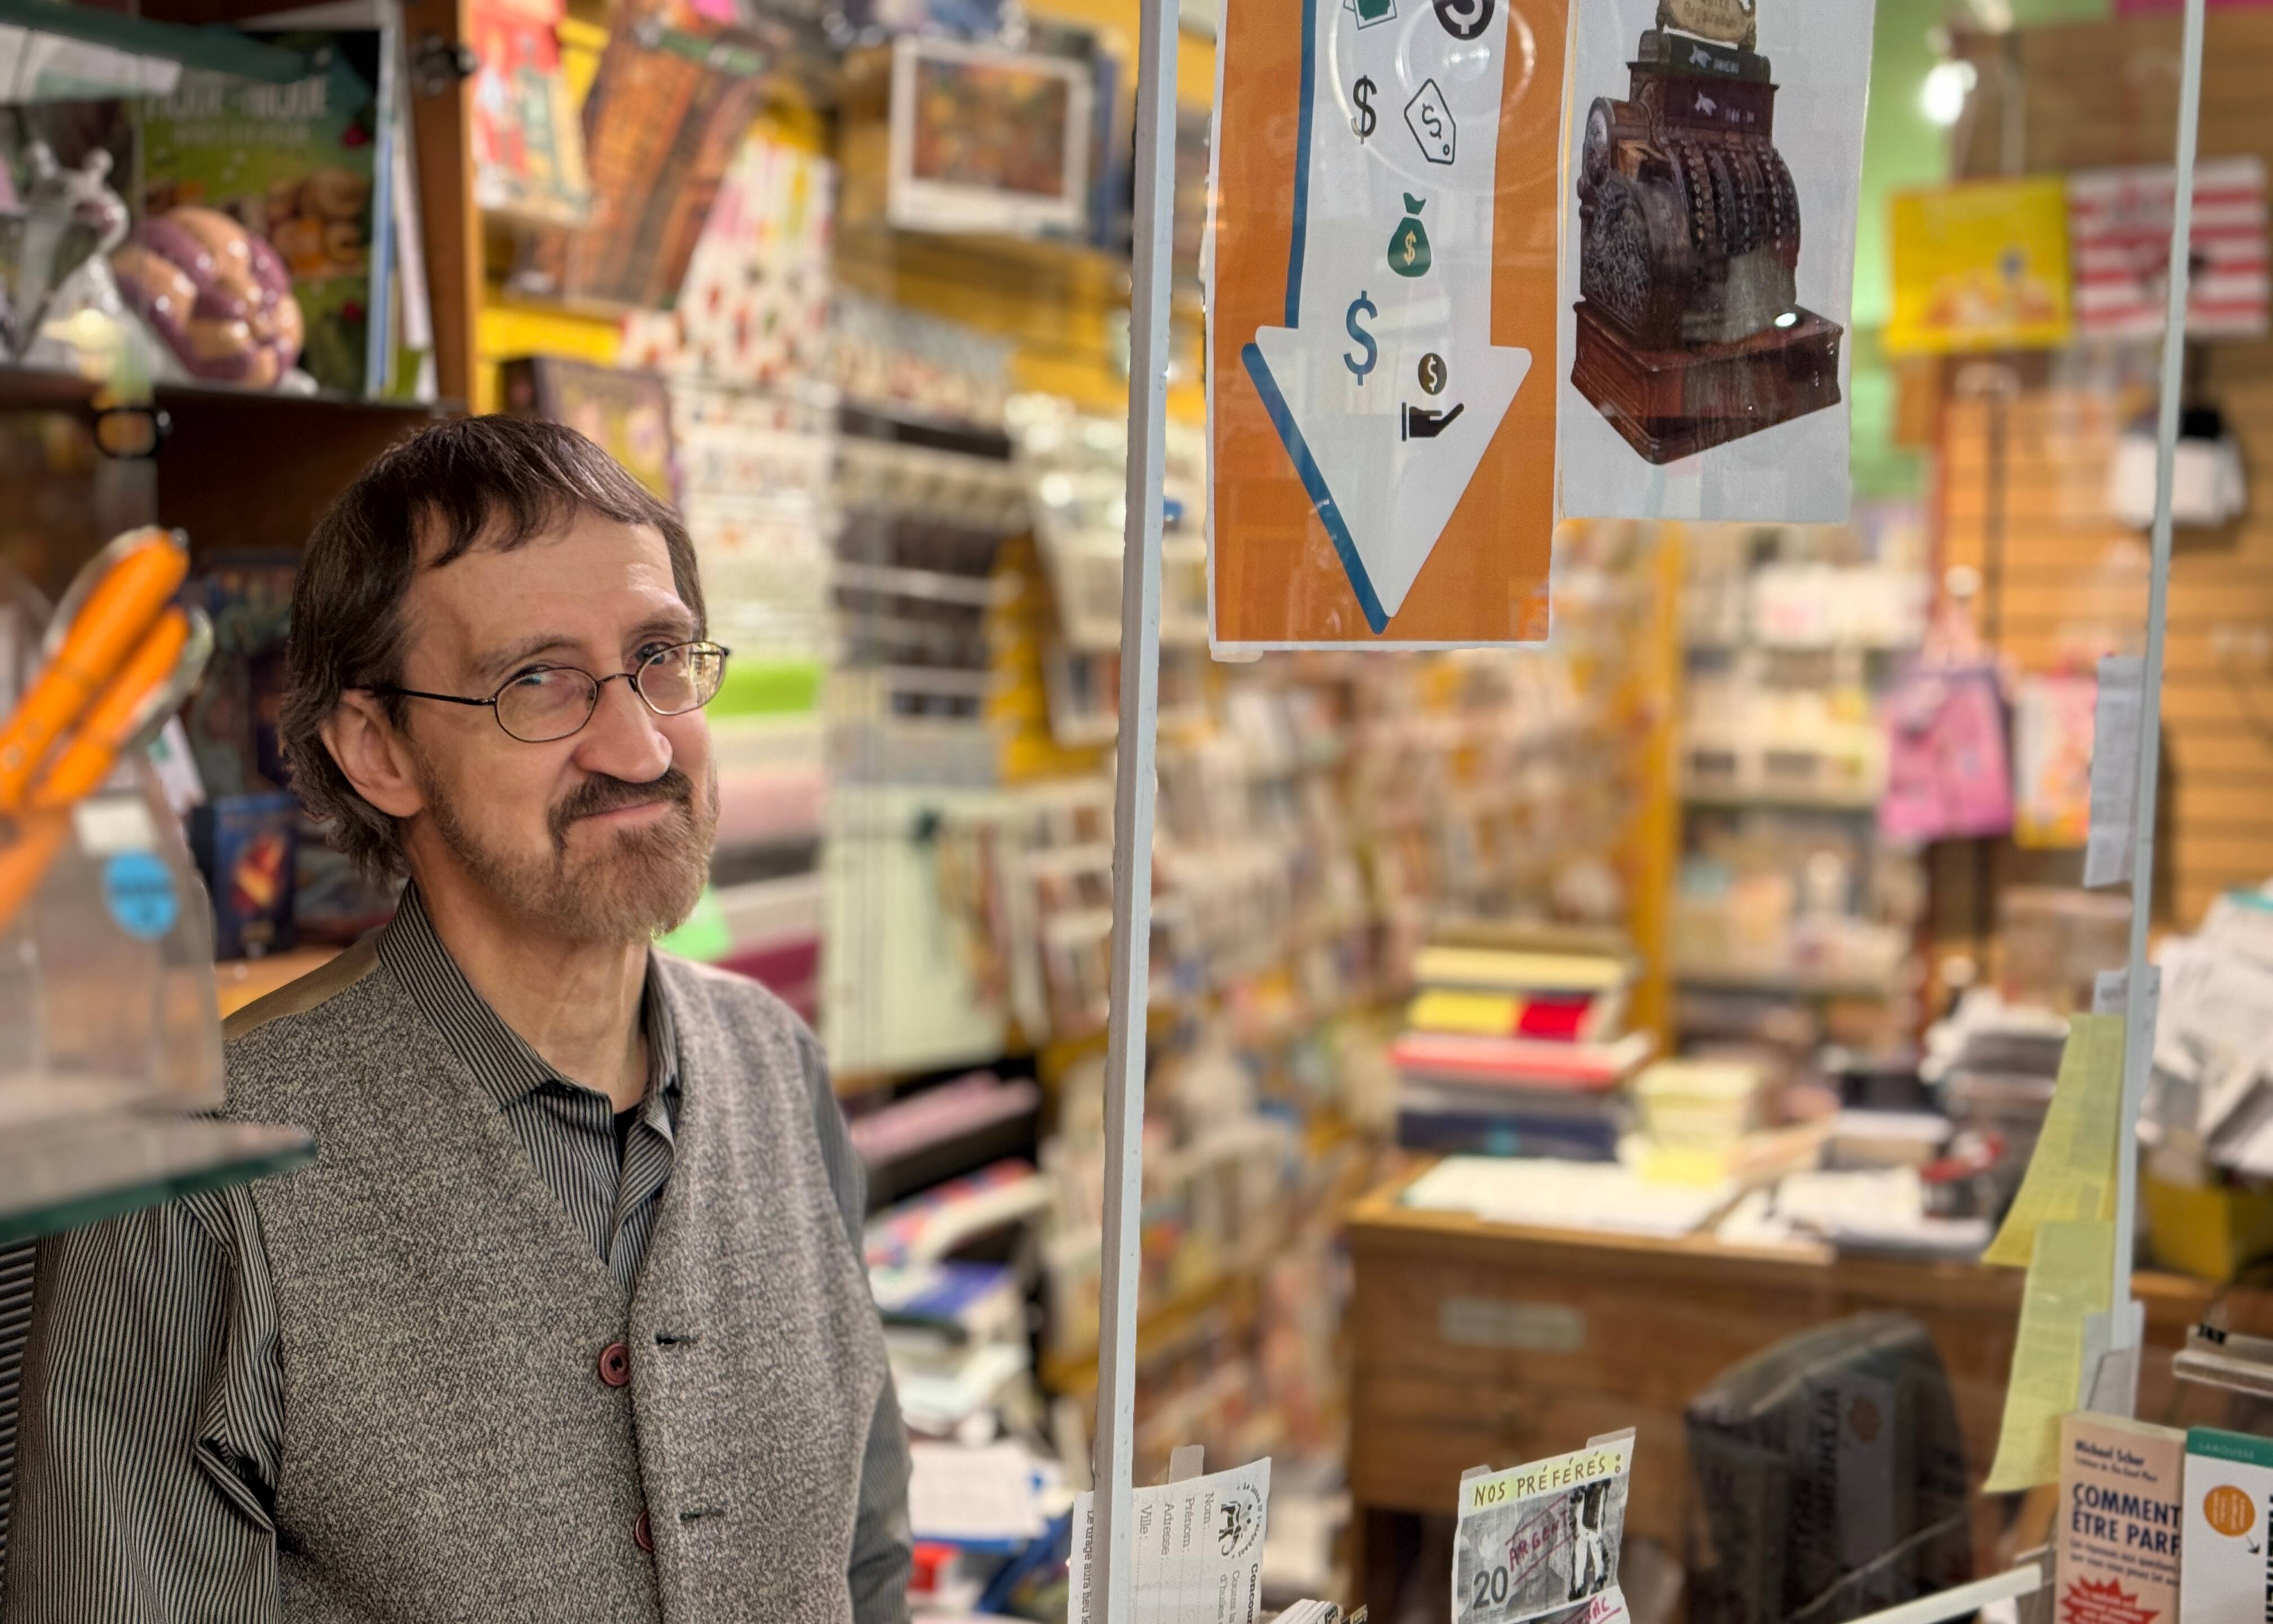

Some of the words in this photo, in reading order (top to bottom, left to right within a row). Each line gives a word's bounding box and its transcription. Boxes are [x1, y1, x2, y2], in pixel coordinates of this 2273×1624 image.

[1474, 1482, 1506, 1507] NOS
[1516, 1452, 1606, 1498] PRÉFÉRÉS
[2073, 1481, 2182, 1528] COMMENT
[1509, 1509, 1568, 1572] ARGENT
[1473, 1565, 1508, 1610] 20
